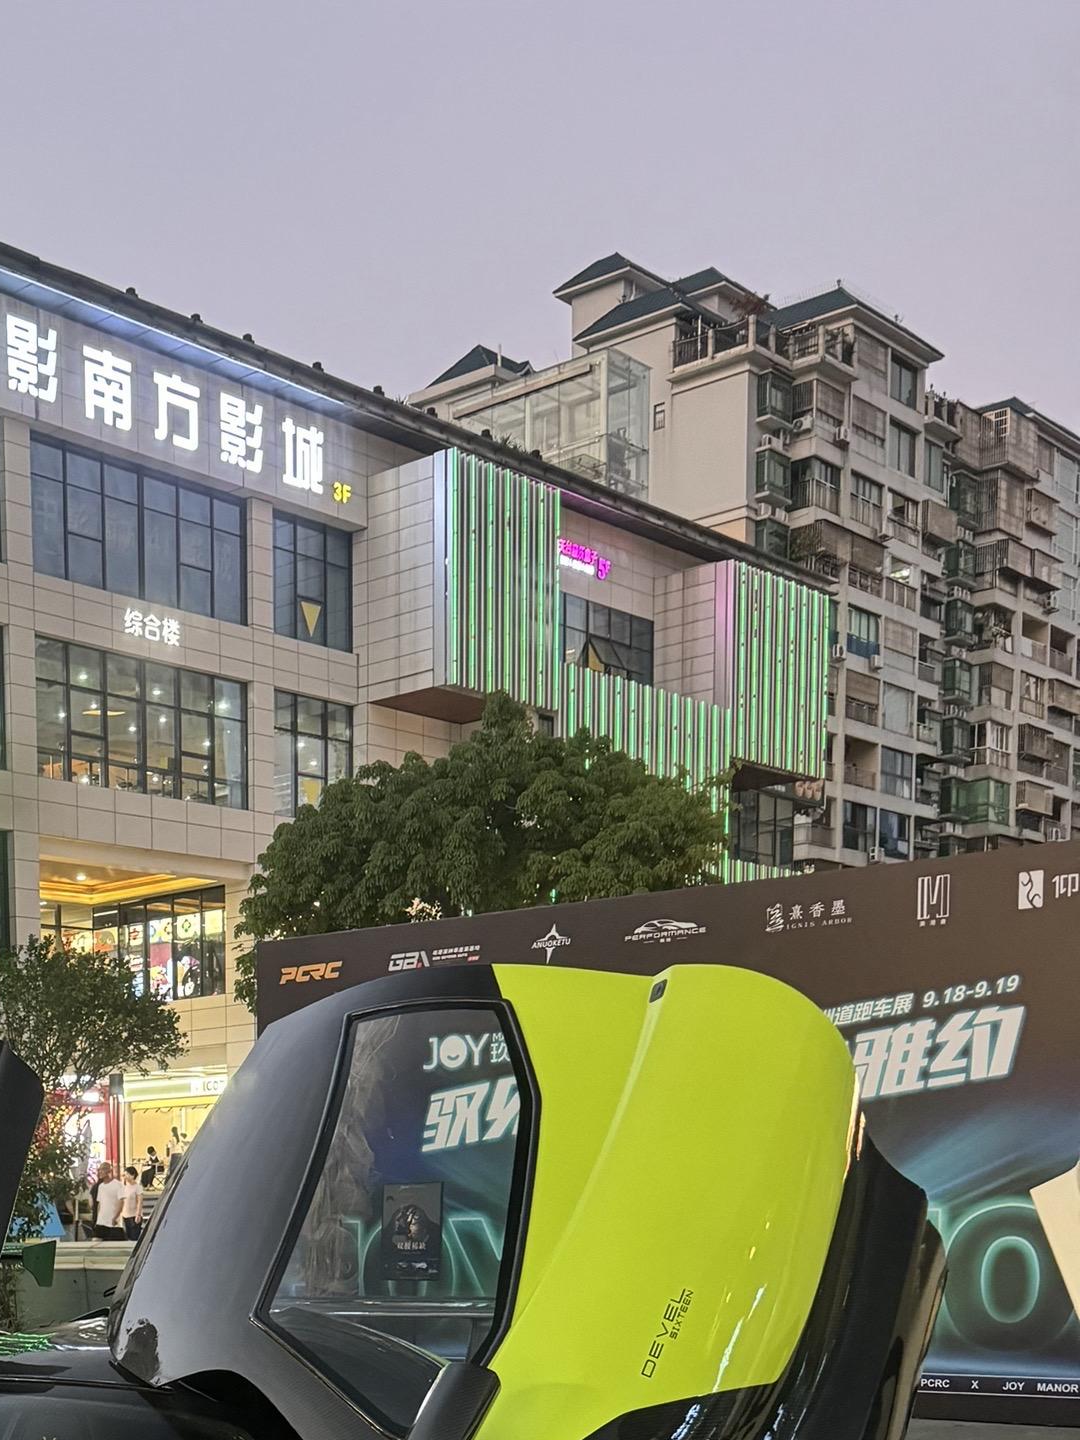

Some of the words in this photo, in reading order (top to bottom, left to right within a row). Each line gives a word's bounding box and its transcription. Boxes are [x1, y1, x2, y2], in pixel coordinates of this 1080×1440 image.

[333, 481, 351, 503] 3F
[124, 607, 180, 647] 综合楼
[624, 926, 707, 942] PERFORMANCE
[786, 920, 817, 930] IGNIS
[821, 916, 853, 927] ARBOR
[531, 936, 571, 949] ANUOKETU
[279, 960, 343, 985] PCRC
[922, 974, 1021, 1008] 9.18-9.19
[423, 1033, 490, 1070] JOY
[669, 1289, 694, 1340] SIXTEEN
[641, 1288, 686, 1378] DEVEL
[920, 1378, 951, 1389] PCRC
[971, 1380, 980, 1389] X
[1002, 1381, 1025, 1391] JOY
[1036, 1382, 1079, 1393] MANOR
